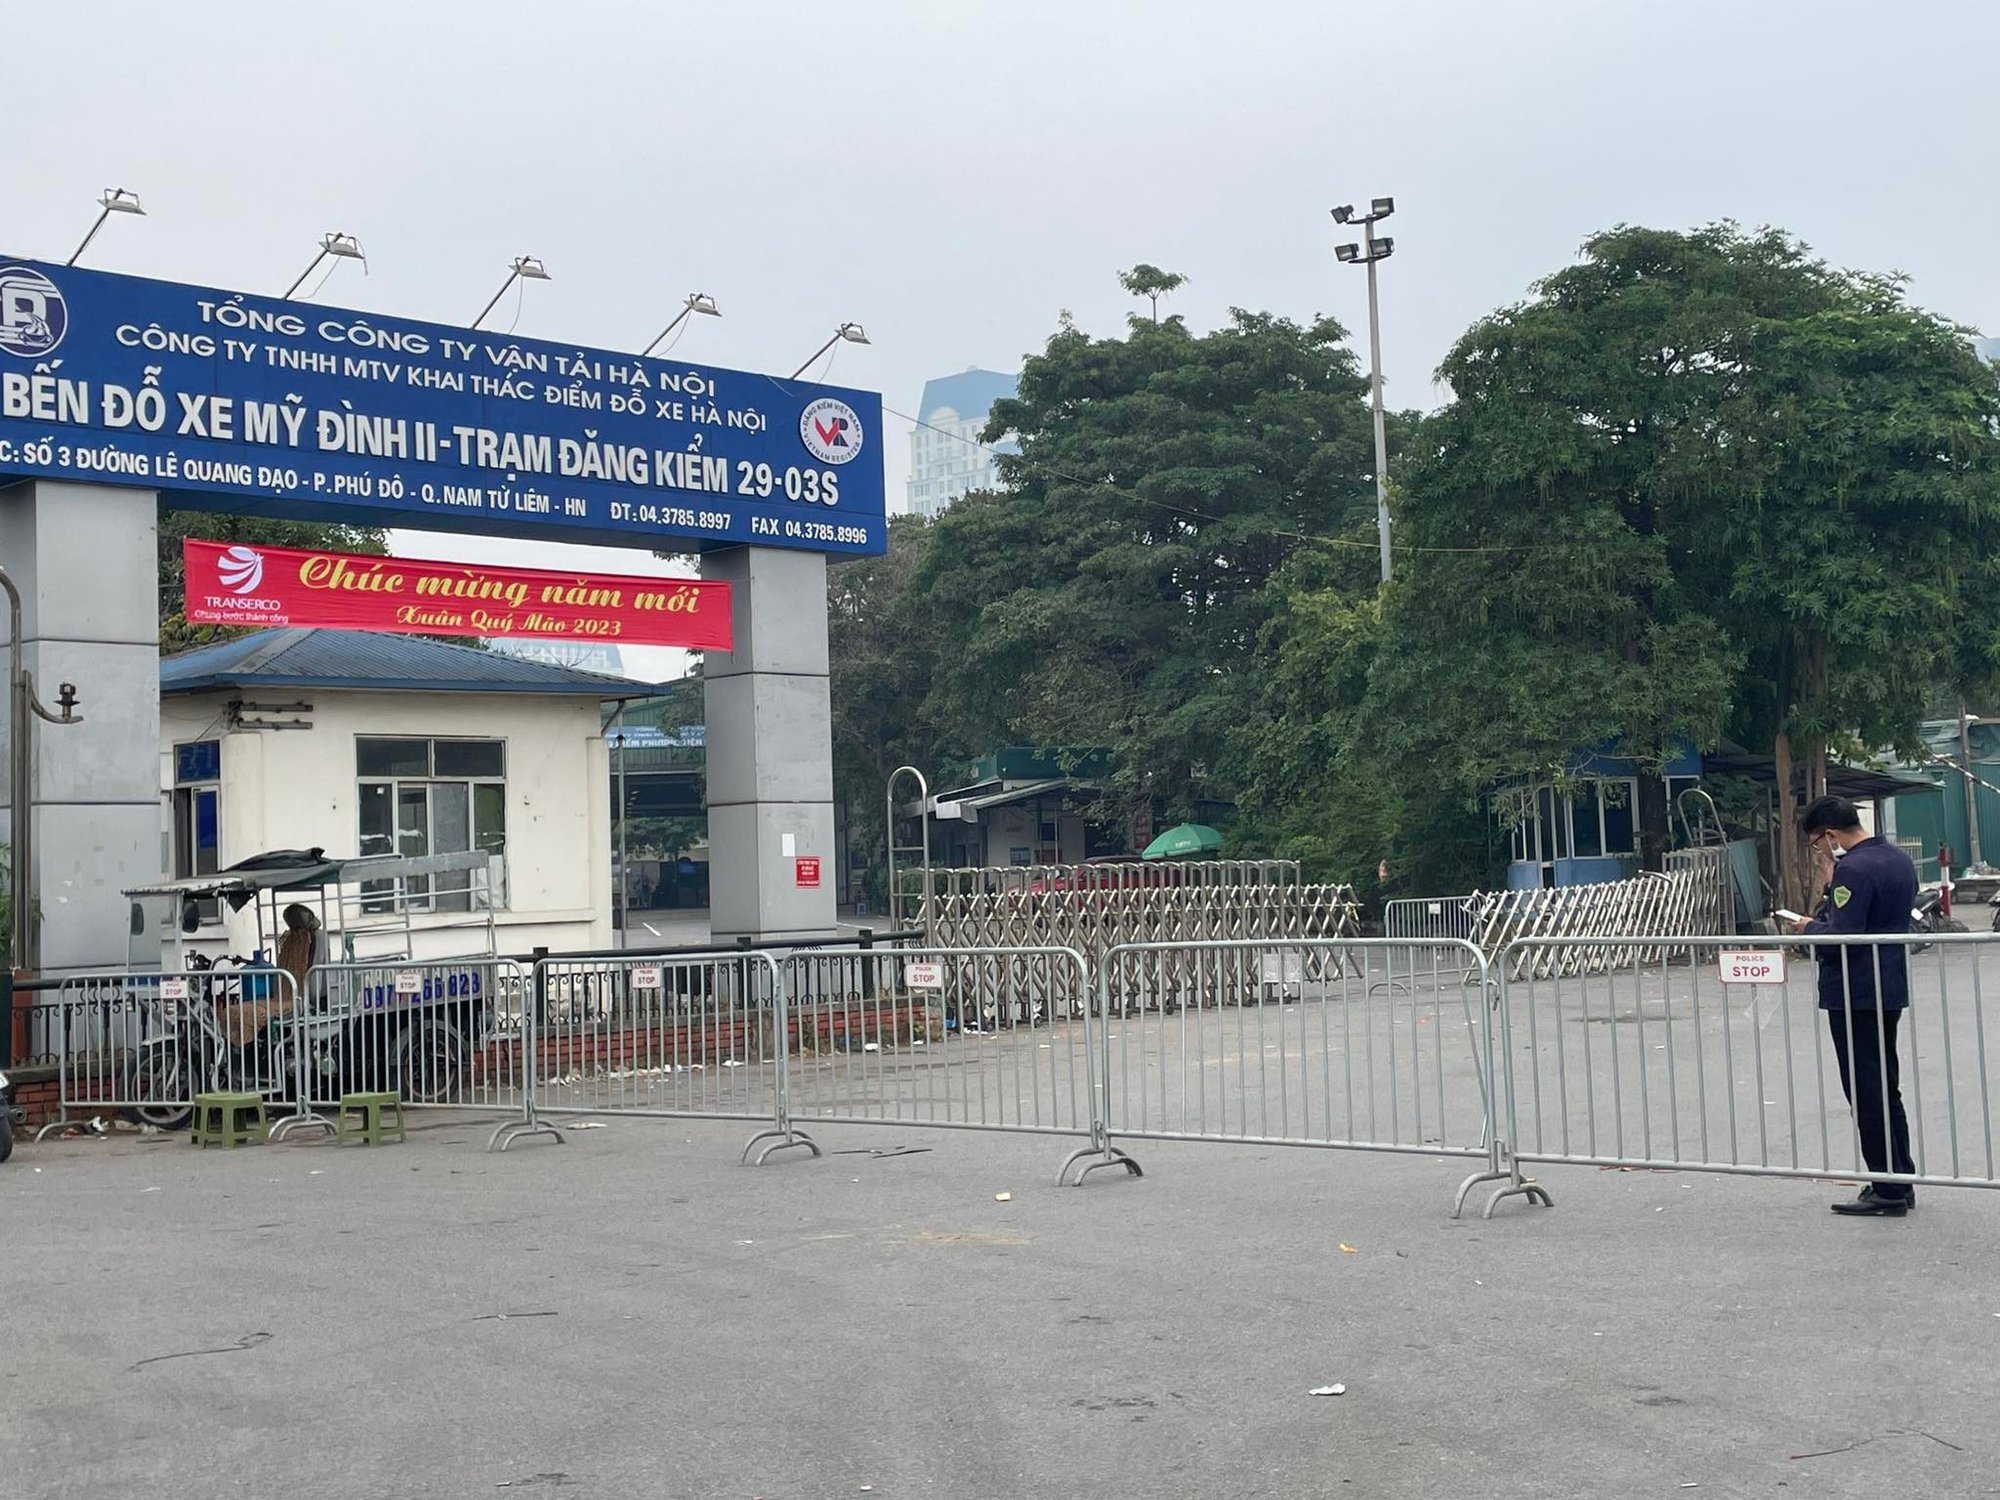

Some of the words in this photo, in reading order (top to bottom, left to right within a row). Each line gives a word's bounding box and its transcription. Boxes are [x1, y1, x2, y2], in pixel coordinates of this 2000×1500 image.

[197, 294, 307, 336] TỔNG
[317, 319, 430, 354] CÔNG
[439, 338, 477, 361] TY
[484, 344, 548, 373] VẬN
[555, 352, 601, 380] TẢI
[608, 361, 652, 389] HÀ
[660, 371, 716, 400] NỘI
[115, 323, 216, 357] CÔNG
[222, 339, 258, 363] TY
[265, 345, 338, 375] TNHH
[343, 358, 401, 383] MTV
[407, 366, 464, 392] KHAI
[470, 369, 535, 400] THÁC
[543, 379, 602, 411] ĐIỂM
[609, 388, 647, 416] ĐỖ
[655, 400, 684, 422] XE
[691, 400, 723, 427] HÀ
[728, 407, 767, 436] NỘI
[2, 359, 89, 425] BẾN
[101, 365, 167, 432] ĐỖ
[177, 391, 234, 441] XE
[244, 393, 307, 447] MỸ
[316, 400, 407, 459] ĐÌNH
[558, 429, 649, 486] ĐĂNG
[655, 433, 729, 494] KIỂM
[736, 459, 839, 507] 29-03S
[24, 436, 55, 466] SỐ
[58, 446, 71, 467] 3
[76, 444, 149, 475] ĐƯỜNG
[155, 452, 178, 478] LÊ
[183, 459, 252, 486] QUANG
[258, 466, 299, 493] ĐẠO
[377, 475, 404, 499] ĐÔ
[487, 485, 510, 509] TỪ
[515, 488, 550, 514] LIÊM
[565, 498, 587, 517] HN
[752, 517, 780, 537] FAX
[785, 520, 867, 545] 04.3785.8996
[300, 556, 405, 593] Chúc
[416, 569, 530, 608] mừng
[541, 578, 624, 609] năm
[634, 585, 700, 613] mới
[204, 596, 281, 612] TRANSERCO
[396, 605, 463, 628] Xuân
[470, 608, 514, 632] Quý
[572, 618, 622, 636] 2023
[400, 981, 417, 989] STOP
[638, 976, 656, 984] STOP
[913, 974, 935, 983] STOP
[1733, 966, 1770, 977] STOP
